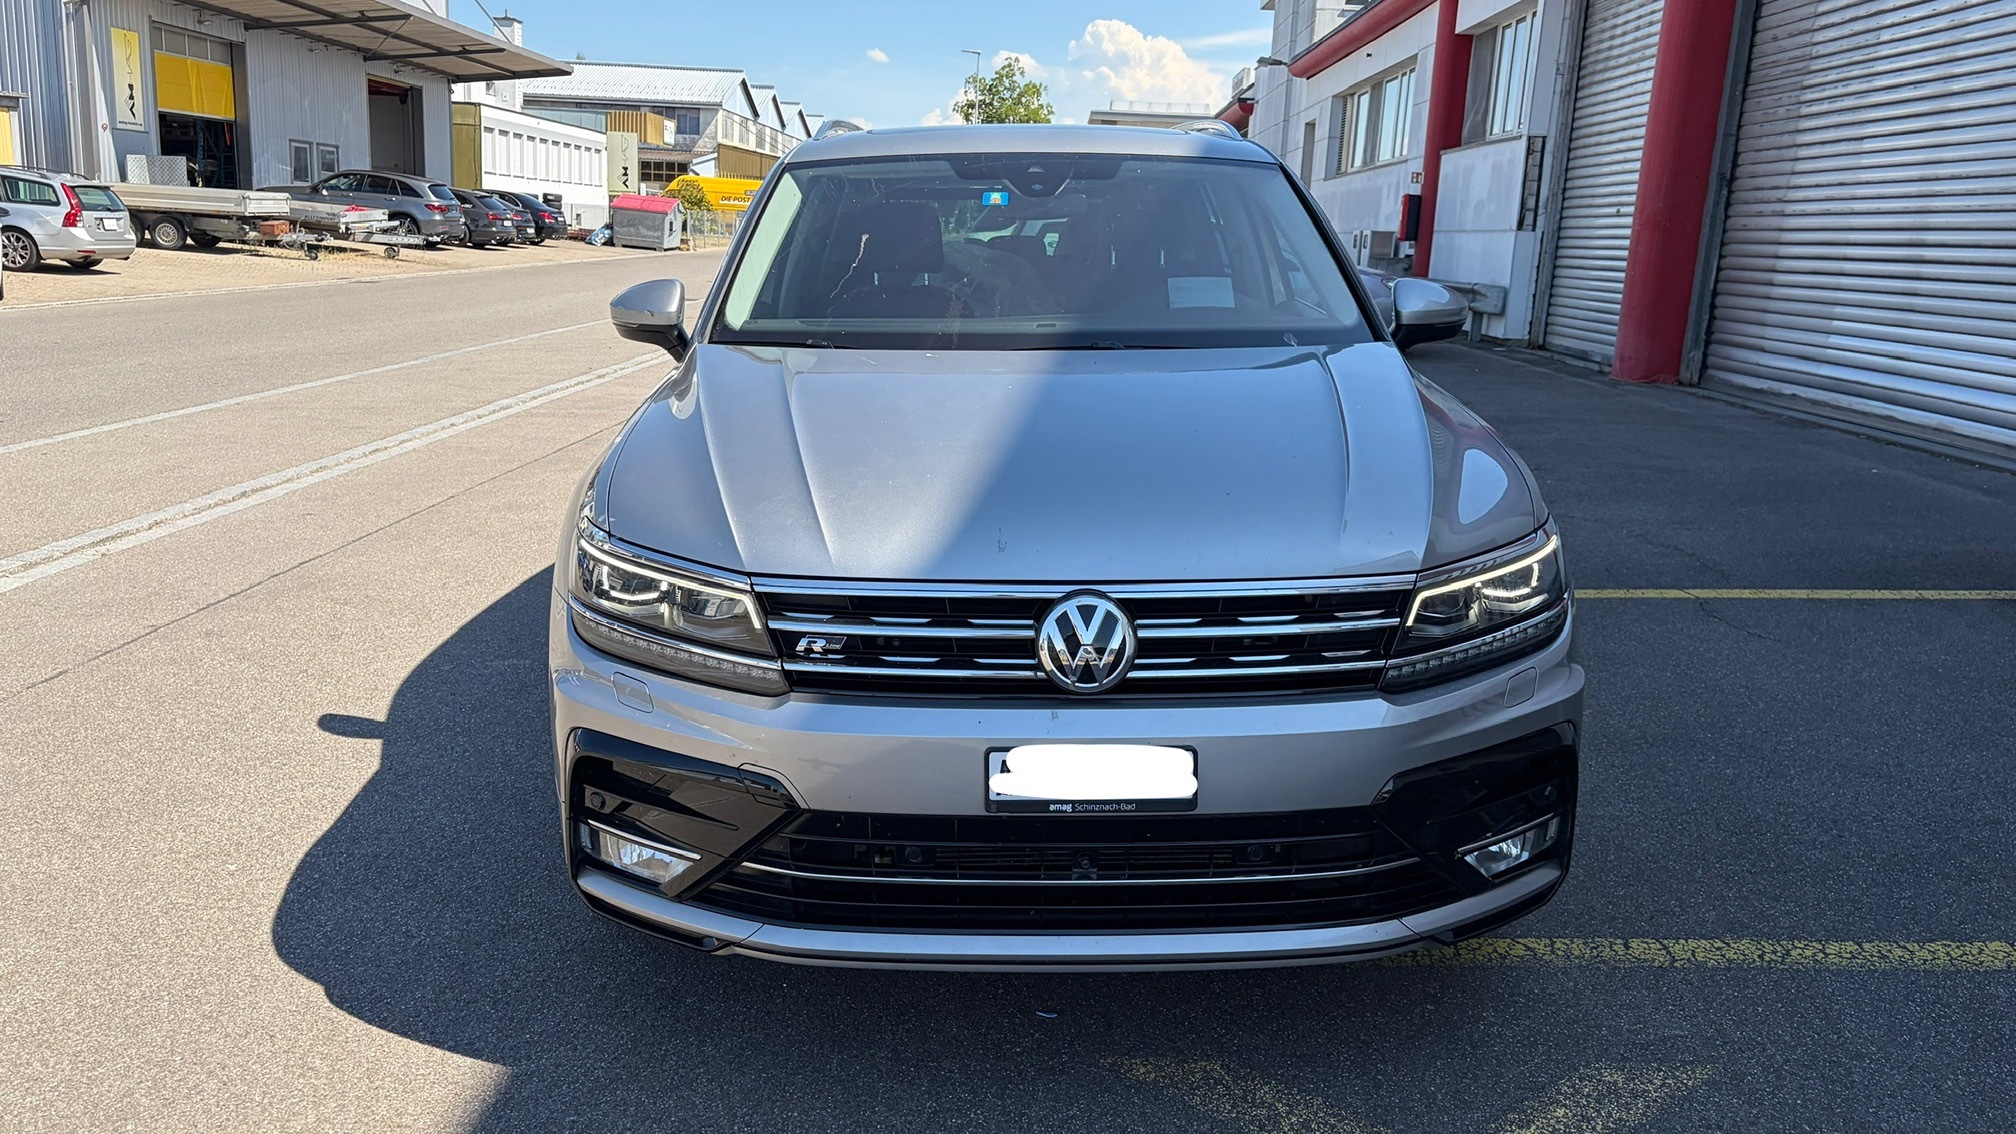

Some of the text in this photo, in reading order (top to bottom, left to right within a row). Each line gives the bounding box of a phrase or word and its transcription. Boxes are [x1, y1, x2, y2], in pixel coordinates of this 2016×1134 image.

[795, 638, 827, 652] R
[1049, 803, 1136, 812] amag Schinznach-Bad
